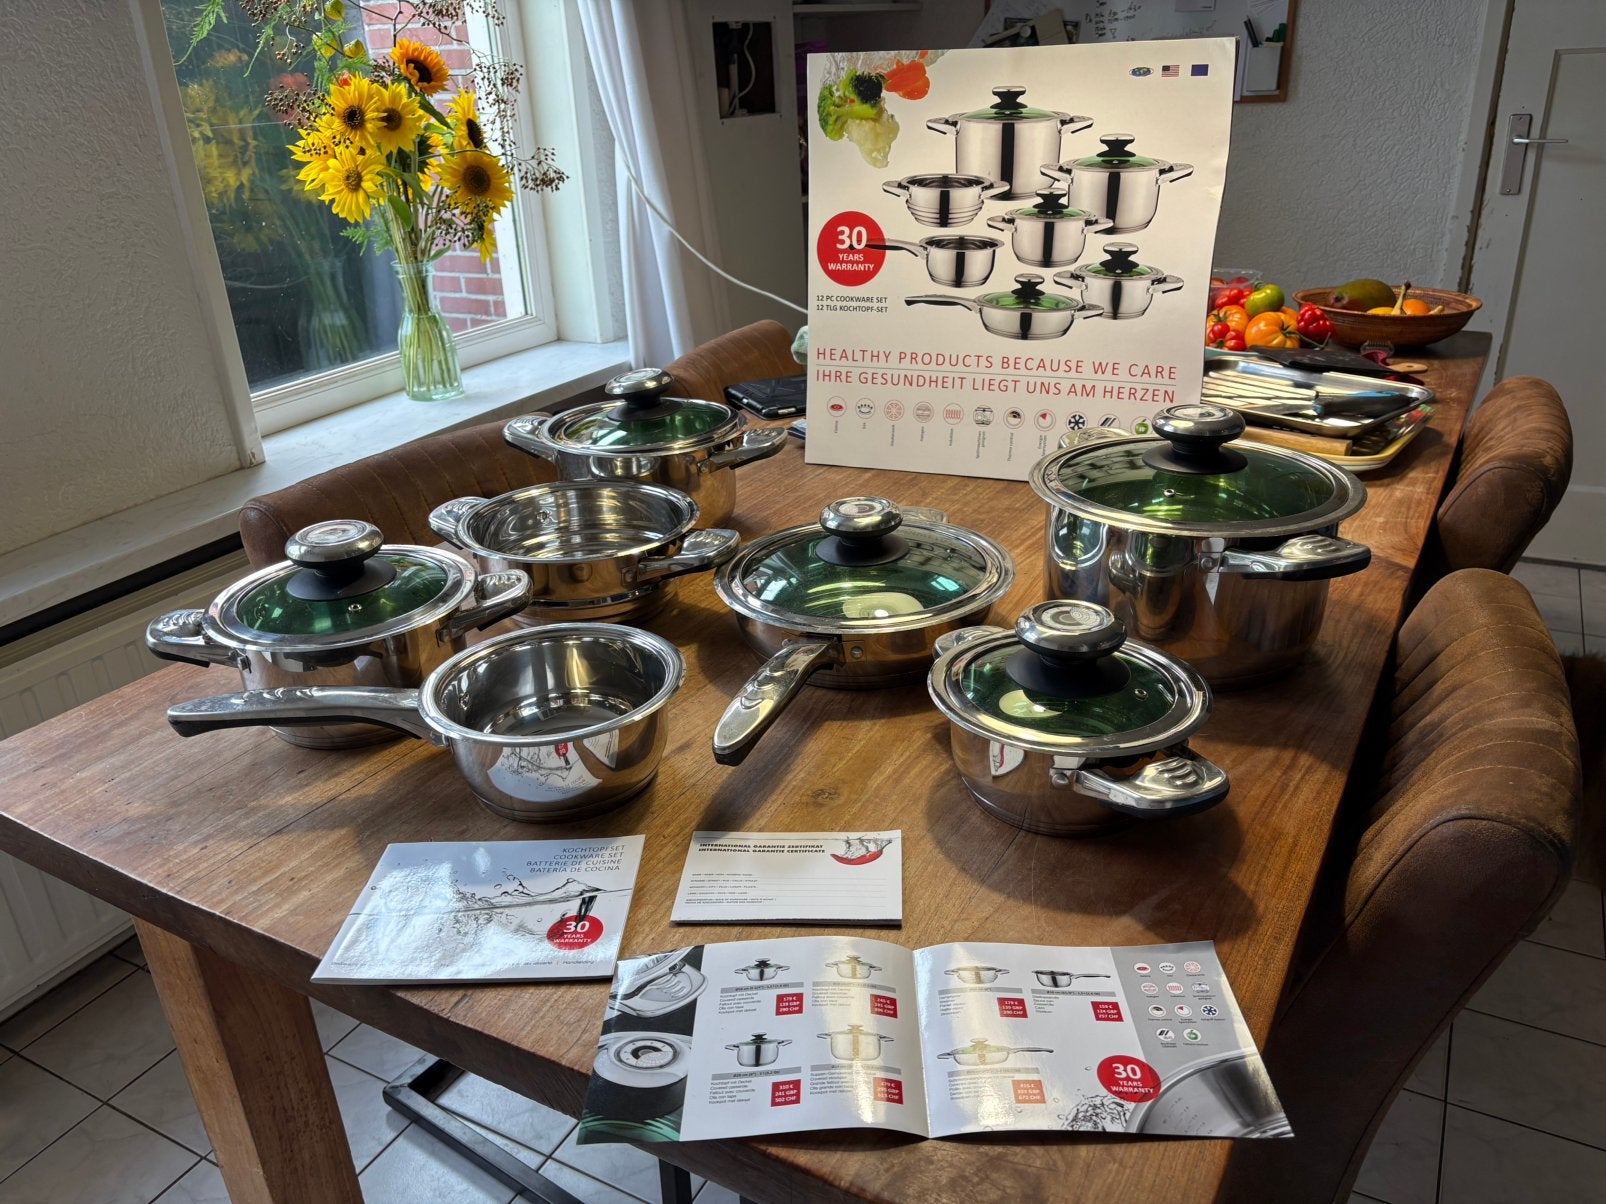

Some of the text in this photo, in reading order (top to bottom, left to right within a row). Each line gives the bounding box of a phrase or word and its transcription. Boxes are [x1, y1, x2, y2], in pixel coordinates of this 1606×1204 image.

[836, 225, 867, 249] 30
[838, 253, 864, 261] YEARS
[828, 262, 874, 271] WARRANTY
[835, 295, 874, 303] COOKWARE
[839, 305, 888, 313] KOCHTOPF-SET
[816, 347, 1177, 380] HEALTHY PRODUCTS BECAUSE WE CARE
[816, 369, 1175, 404] IHRE GESUNDHEIT LIEGT UNS AM HERZEN
[610, 844, 626, 852] SET
[553, 851, 624, 860] COOKWARE SET
[585, 858, 622, 866] CUISINE
[563, 921, 590, 932] 30
[1112, 1063, 1142, 1079] 30
[1110, 1085, 1154, 1093] WARRANTY
